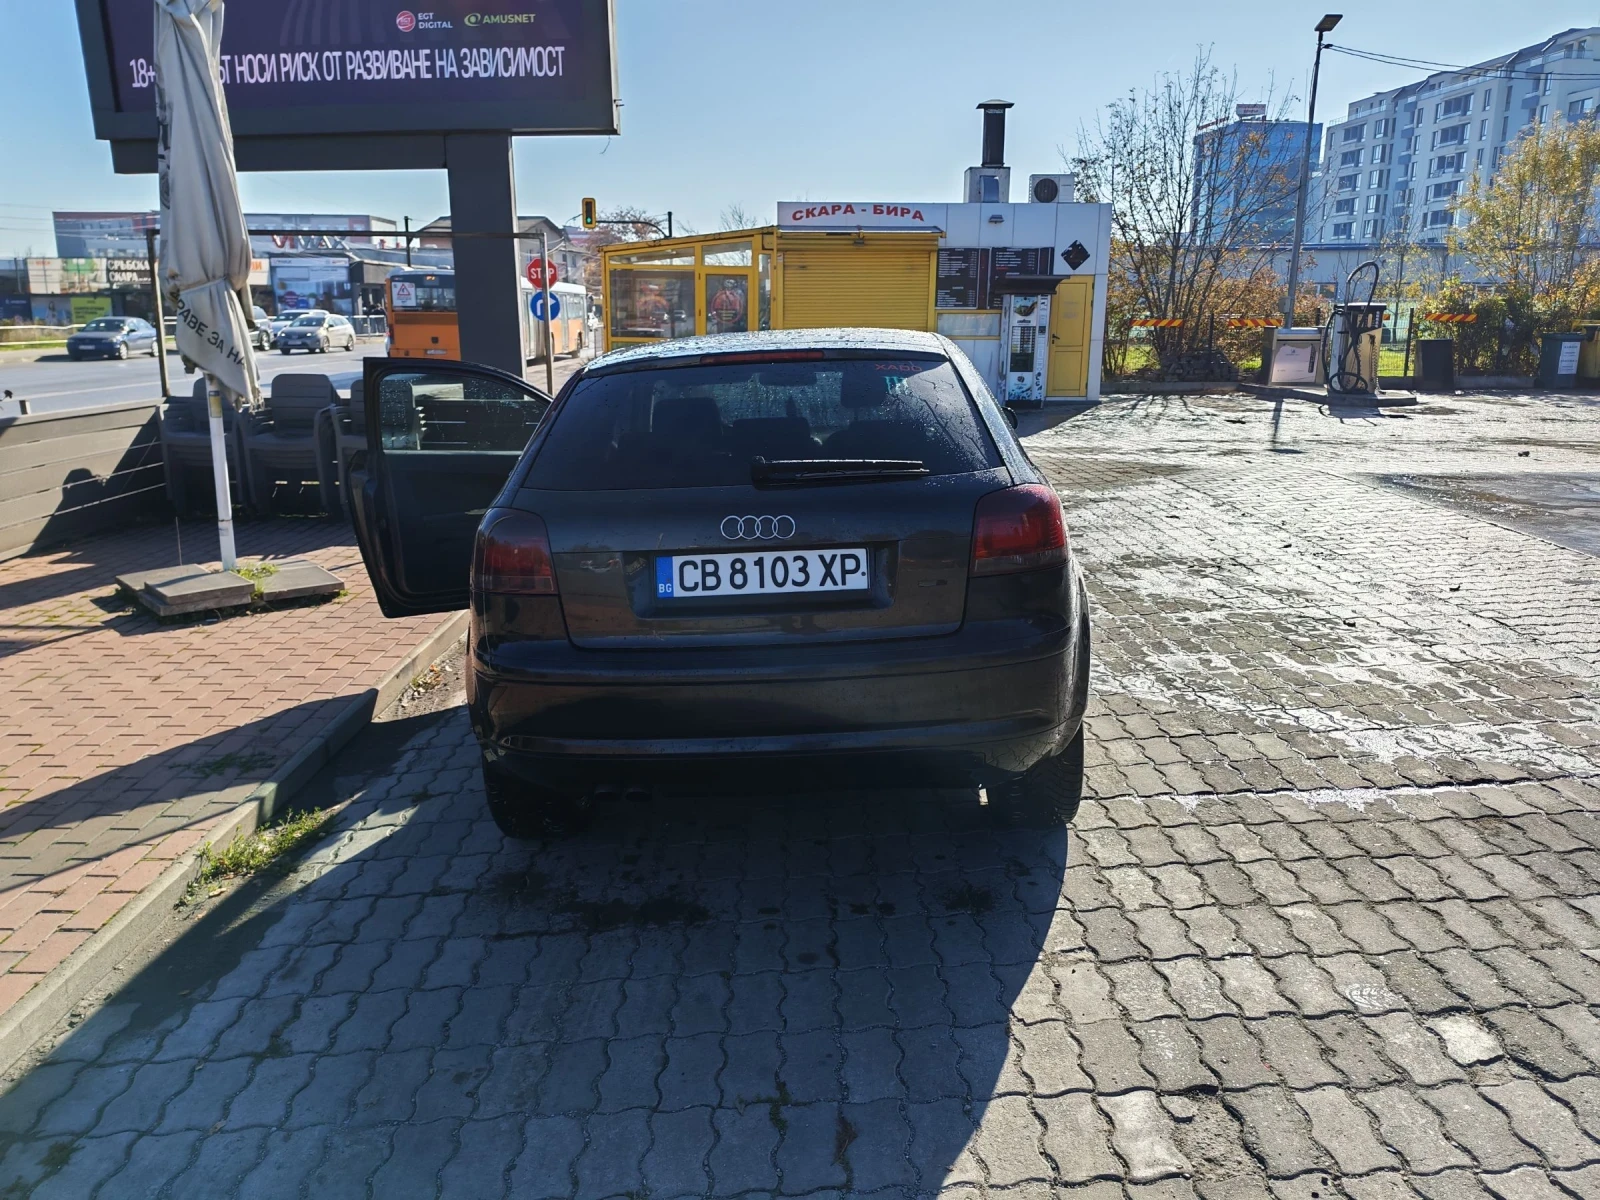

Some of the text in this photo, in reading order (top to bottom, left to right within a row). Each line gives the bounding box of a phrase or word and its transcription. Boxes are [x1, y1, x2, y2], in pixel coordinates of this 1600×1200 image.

[418, 12, 434, 20] EGT
[483, 13, 536, 24] AMUSNET
[418, 20, 453, 29] DIGITAL
[129, 58, 156, 88] 18+
[234, 53, 278, 84] НОСИ
[279, 51, 321, 83] РИСК
[322, 51, 342, 82] ОТ
[346, 49, 432, 81] РАЗВИВАНЕ
[435, 48, 459, 79] НА
[460, 46, 565, 79] ЗАВИСИМОСТ
[792, 203, 856, 221] СКАРА
[872, 204, 925, 221] БИРА
[530, 267, 555, 279] STP
[207, 331, 225, 354] ЗА
[658, 553, 861, 593] BG CB 8103 XP
